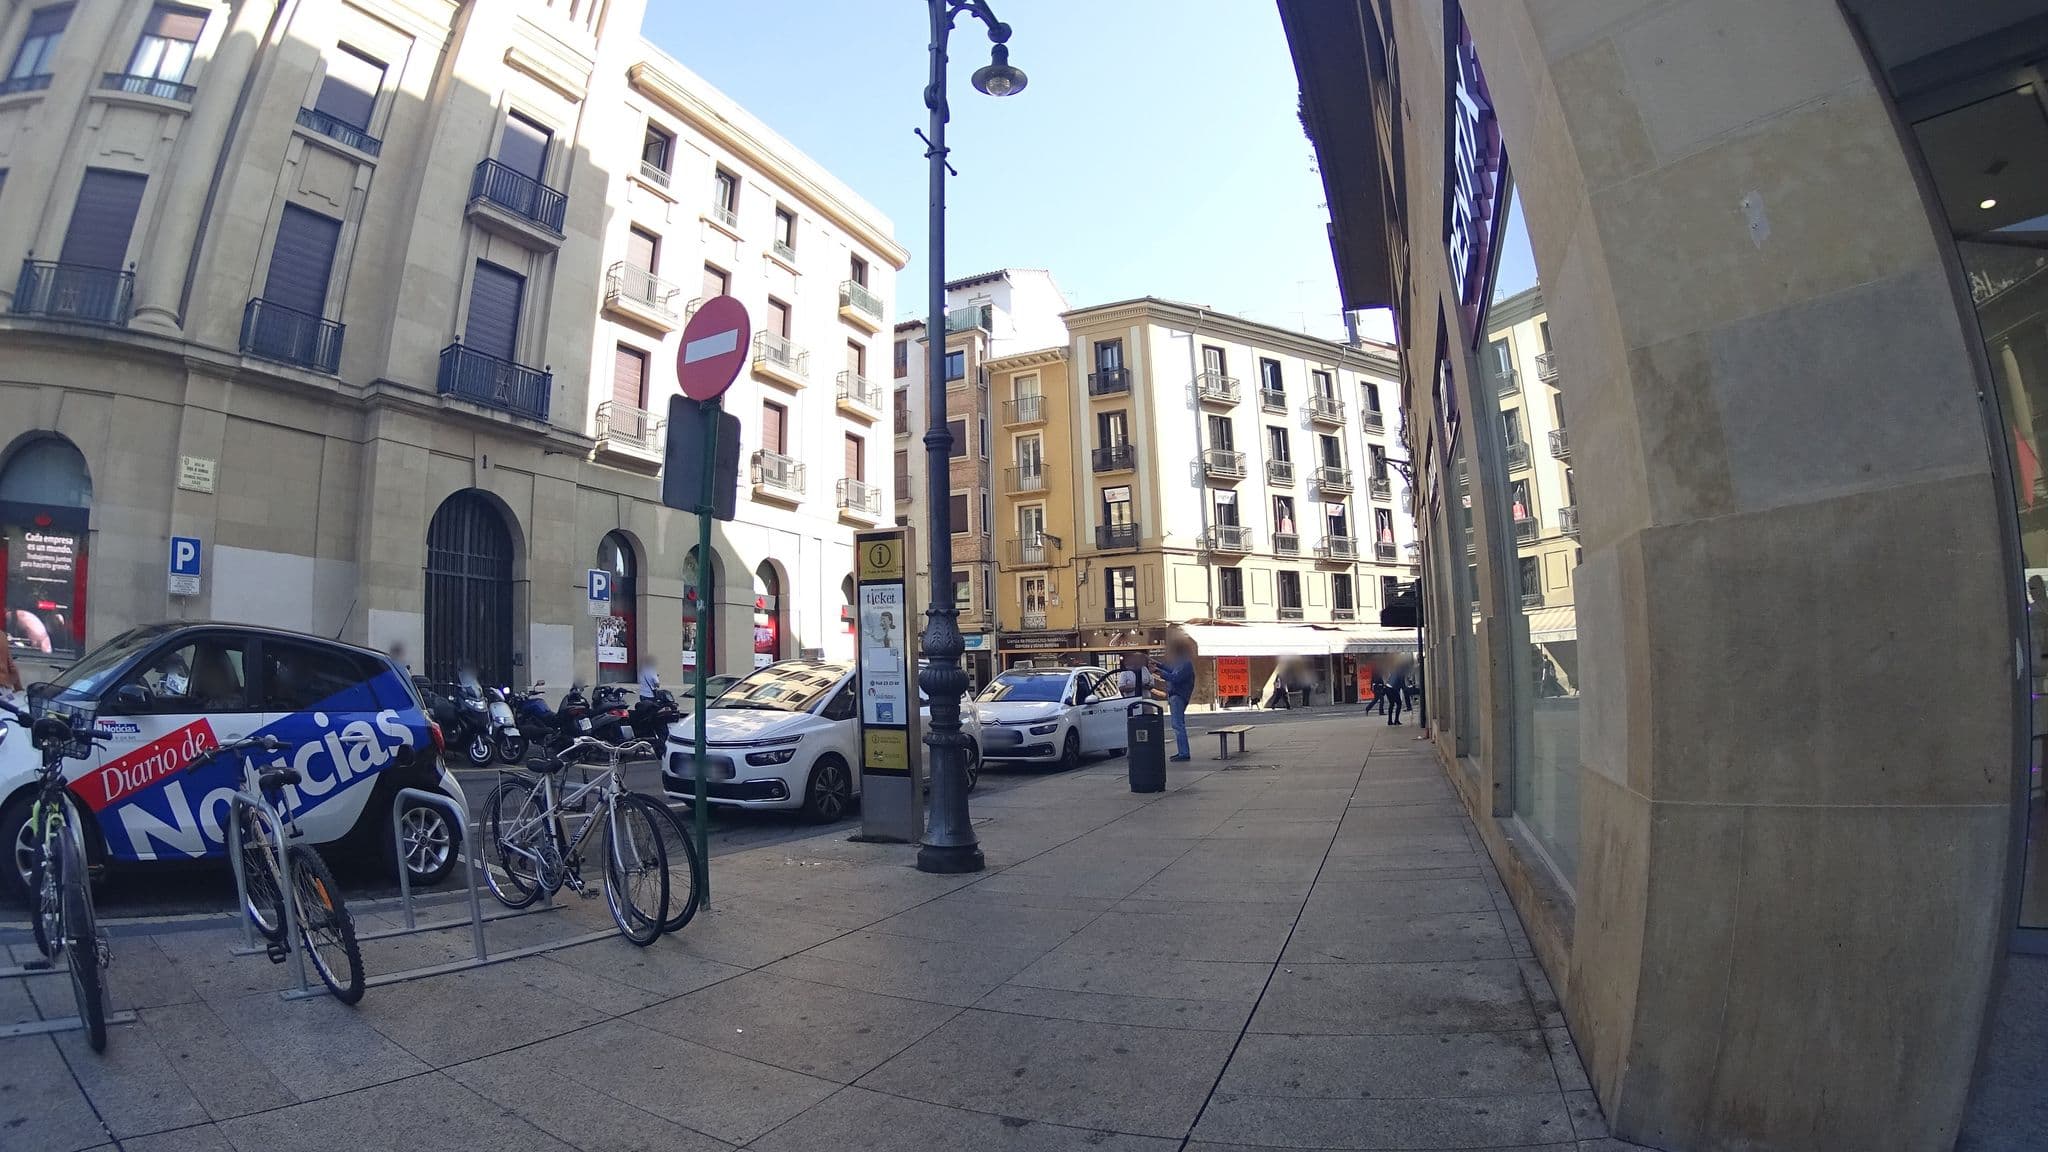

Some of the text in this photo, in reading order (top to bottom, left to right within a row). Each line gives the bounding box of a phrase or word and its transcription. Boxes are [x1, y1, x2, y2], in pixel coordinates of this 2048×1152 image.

[25, 533, 73, 545] Cada empresa
[46, 545, 72, 554] mundo.
[176, 541, 195, 570] P
[592, 573, 606, 598] P
[867, 592, 896, 605] ticket
[103, 723, 136, 732] Noticias
[102, 731, 207, 802] Diario de
[118, 709, 415, 861] Noticias
